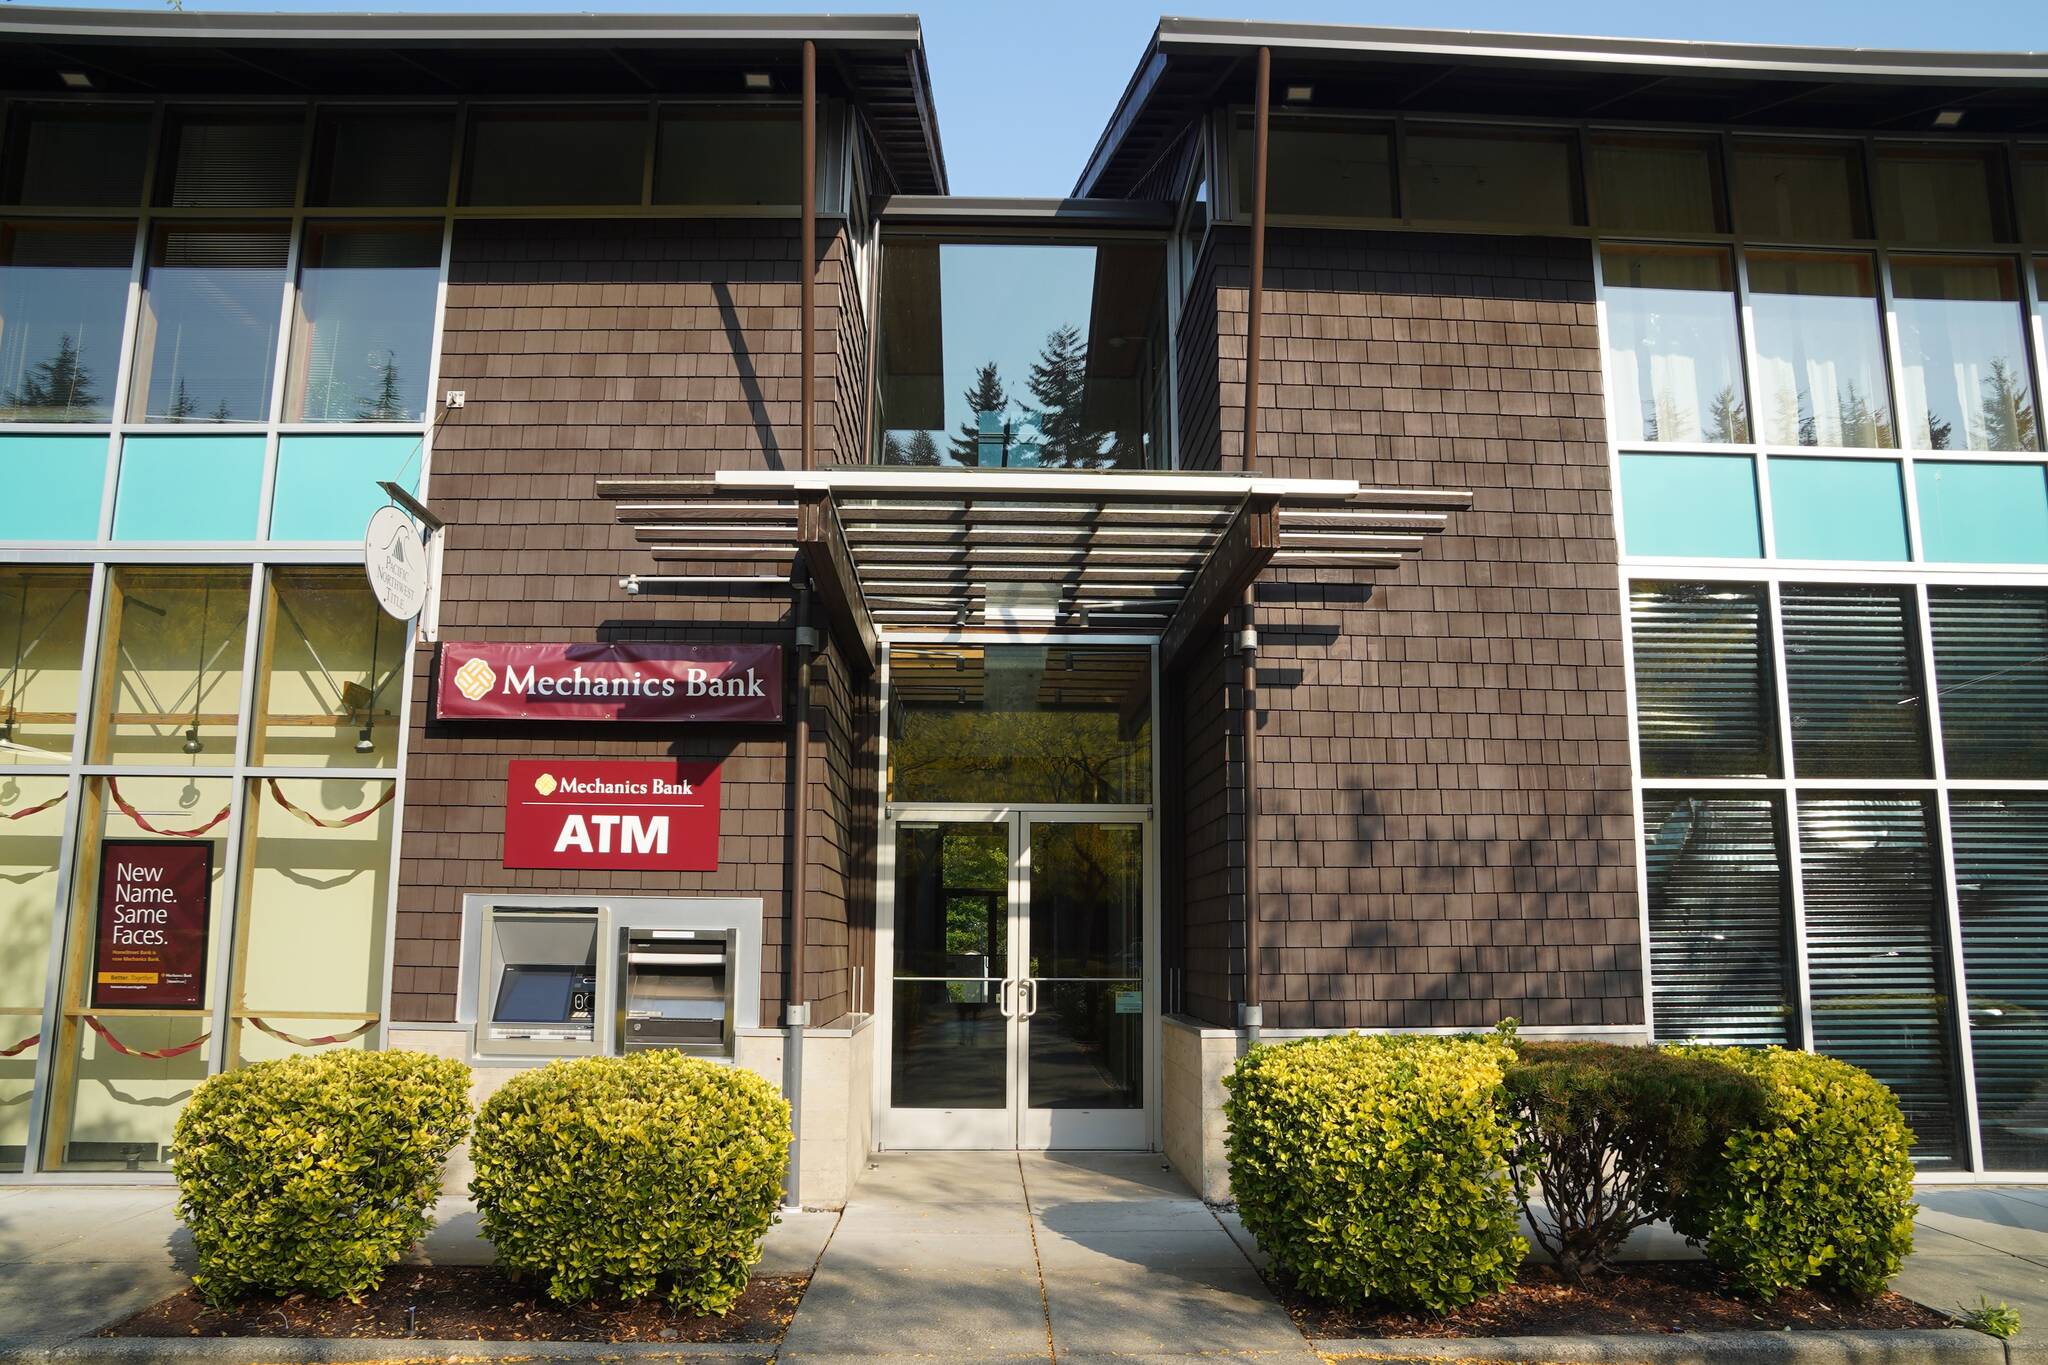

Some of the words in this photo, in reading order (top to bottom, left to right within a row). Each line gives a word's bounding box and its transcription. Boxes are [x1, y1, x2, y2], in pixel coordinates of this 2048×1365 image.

[502, 664, 675, 697] Mechanics
[686, 667, 766, 698] Bank
[559, 777, 648, 795] Mechanics
[652, 778, 693, 795] Bank
[553, 814, 669, 855] ATM
[117, 863, 163, 882] New
[115, 883, 177, 903] Name.
[113, 904, 168, 924] Same
[112, 925, 169, 945] Faces.
